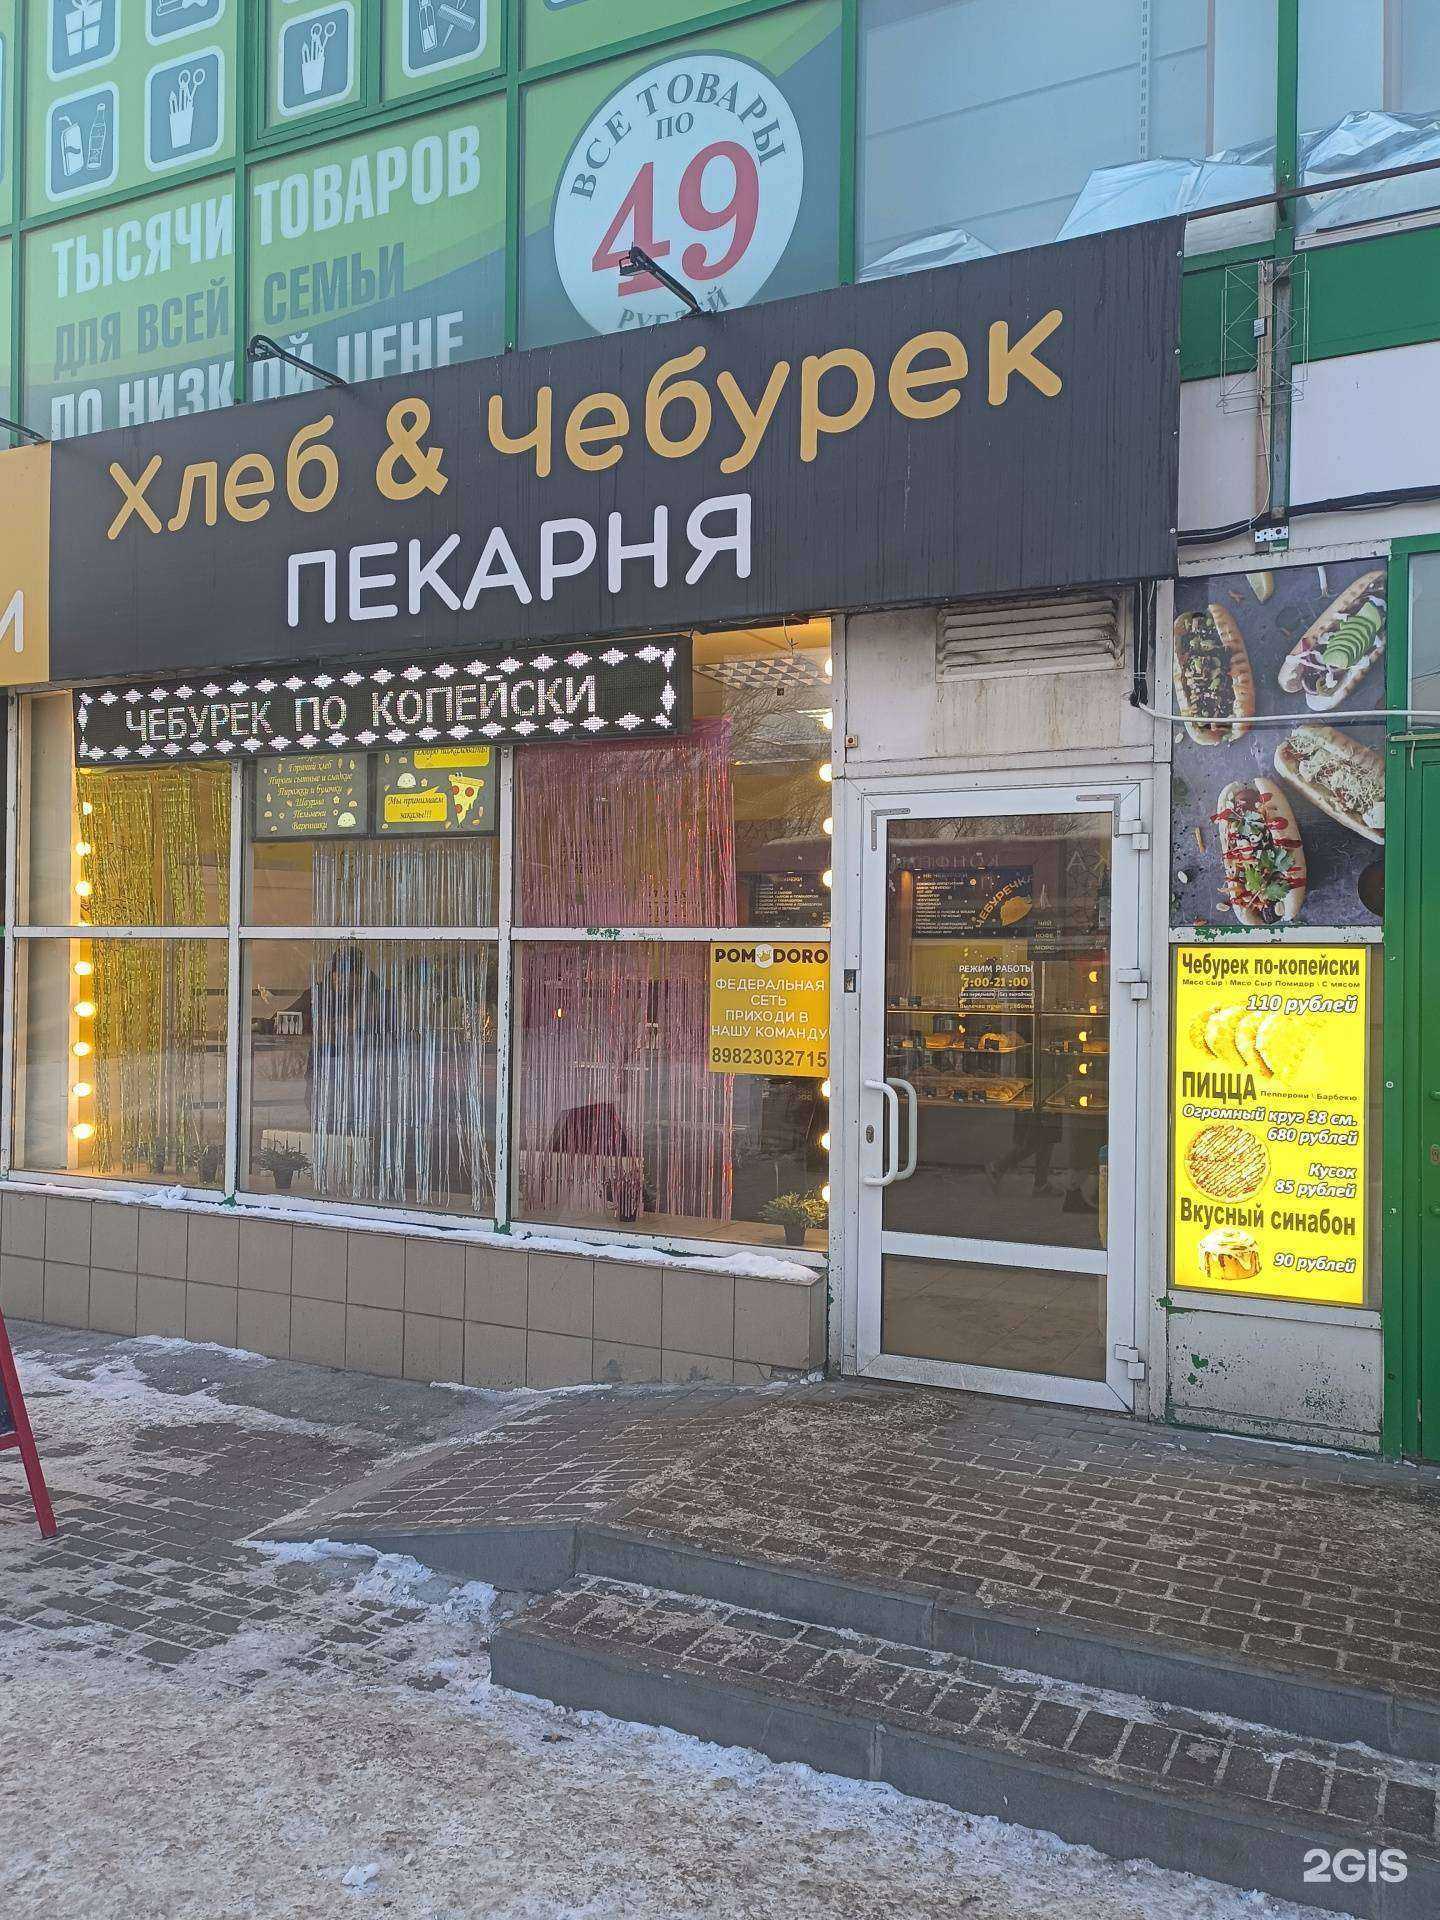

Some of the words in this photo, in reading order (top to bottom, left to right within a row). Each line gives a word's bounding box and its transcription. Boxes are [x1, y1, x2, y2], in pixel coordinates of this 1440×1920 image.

[570, 110, 632, 201] ВСЕ
[636, 72, 786, 167] ТОВАРЫ
[656, 111, 694, 140] ПО
[52, 194, 233, 298] ТЫСЯЧИ
[254, 125, 481, 246] ТОВАРОВ
[592, 140, 759, 297] 49
[53, 312, 121, 380] ДЛЯ
[138, 276, 229, 354] ВСЕЙ
[263, 242, 405, 326] СЕМЬИ
[107, 414, 339, 540] Хлеб
[376, 397, 449, 500] &
[287, 493, 752, 627] ПЕКАРНЯ
[125, 700, 273, 741] ЧЕБУРЕК
[294, 695, 347, 732] ПО
[371, 674, 596, 727] КОПЕЙСКИ
[959, 965, 993, 973] РЕЖИМ
[995, 965, 1034, 973] РАБОТЫ
[1182, 953, 1249, 979] Чебурек
[1254, 954, 1360, 976] по-копейски
[715, 978, 824, 992] ФЕДЕРАЛЬНАЯ
[1254, 980, 1272, 988] Сыр
[1275, 980, 1315, 988] Помидор
[751, 994, 787, 1006] СЕТЬ
[1246, 994, 1282, 1011] 110
[1284, 994, 1358, 1015] рублей
[725, 1009, 795, 1024] ПРИХОДИ
[799, 1011, 808, 1023] В
[711, 1025, 751, 1037] НАШУ
[712, 1047, 828, 1068] 89823032715
[1182, 1071, 1257, 1105] ПИЦЦА
[1183, 1103, 1266, 1121] Огромный
[1268, 1110, 1304, 1126] круг
[1307, 1110, 1328, 1124] 38
[1330, 1114, 1358, 1126] см.
[1267, 1127, 1297, 1142] 680
[1298, 1129, 1358, 1146] рублей
[1309, 1163, 1357, 1179] Кусок
[1274, 1180, 1295, 1194] 85
[1296, 1181, 1357, 1198] рублей
[1180, 1197, 1265, 1230] Вкусный
[1270, 1208, 1356, 1236] синабон
[1273, 1252, 1295, 1266] 90
[1297, 1253, 1357, 1273] рублей
